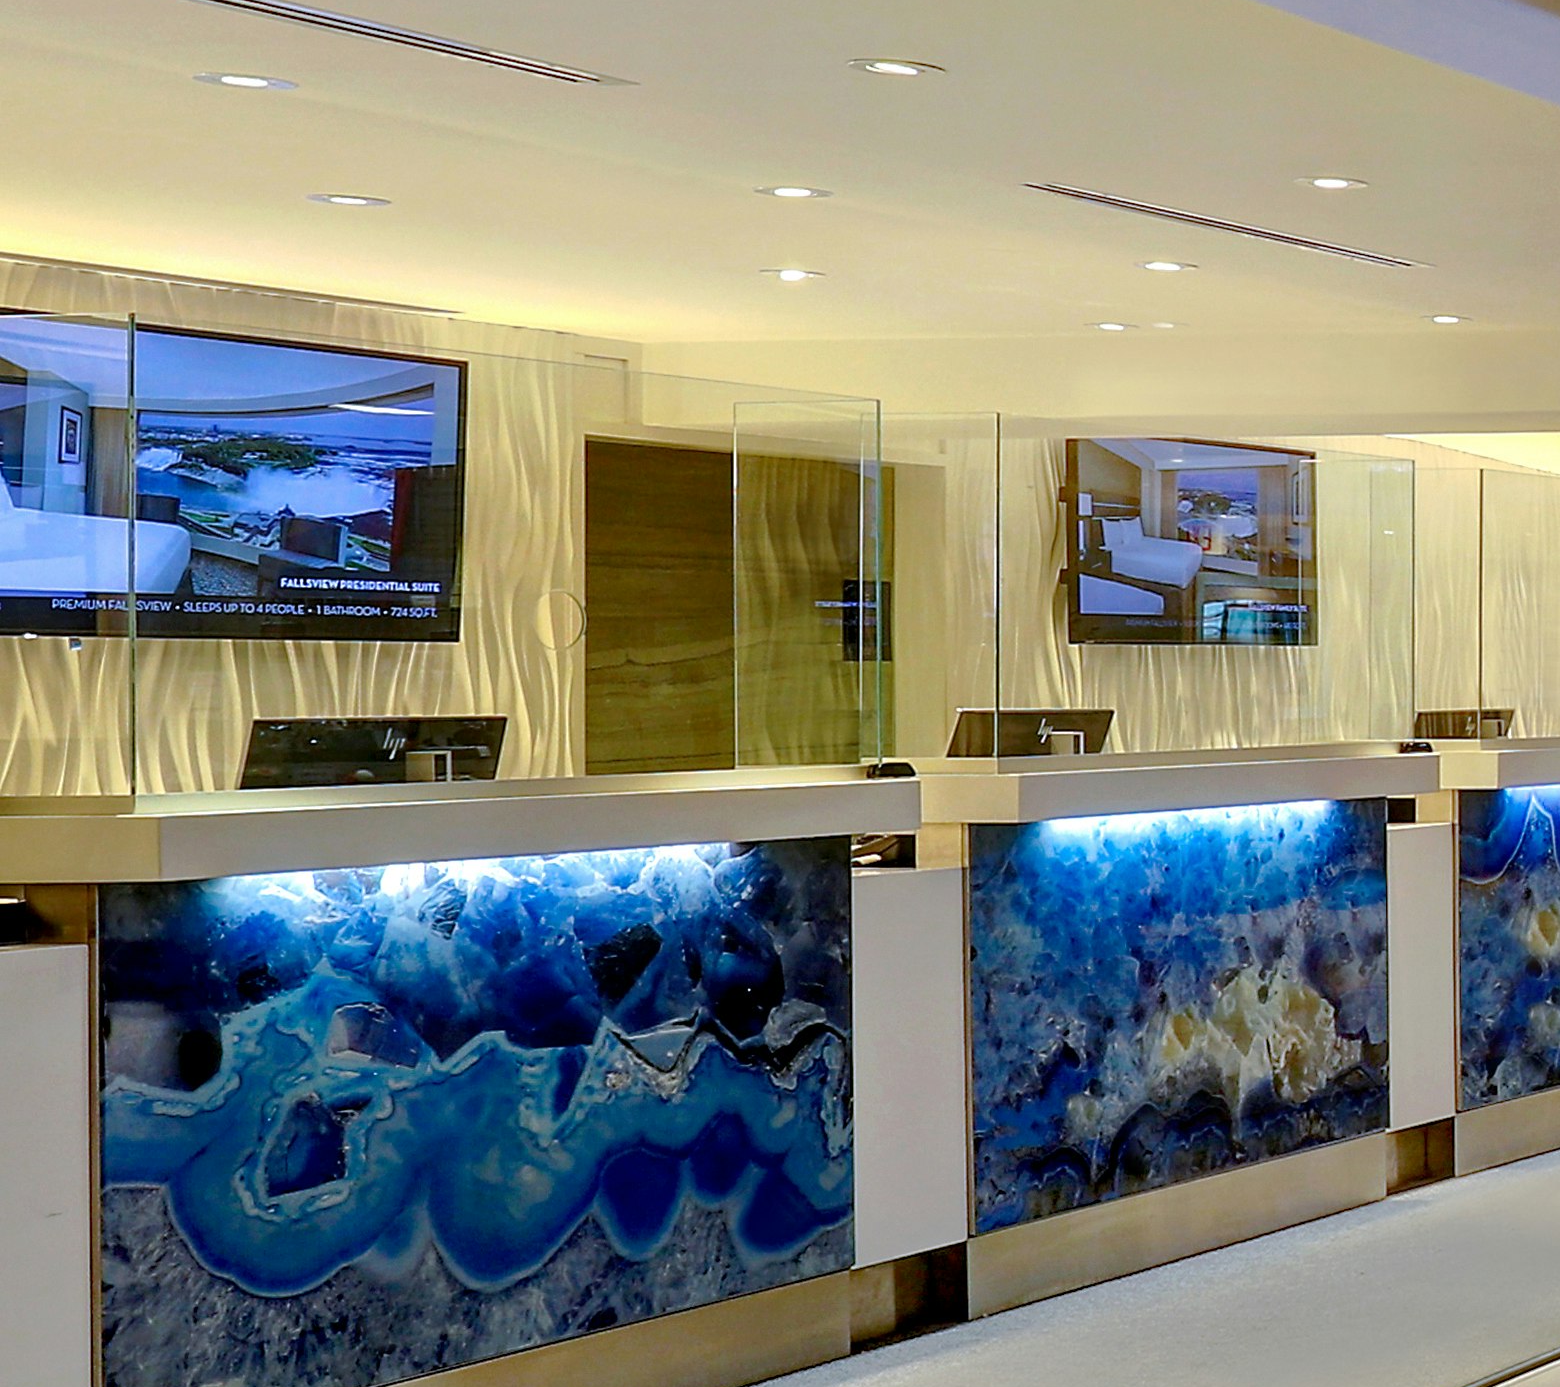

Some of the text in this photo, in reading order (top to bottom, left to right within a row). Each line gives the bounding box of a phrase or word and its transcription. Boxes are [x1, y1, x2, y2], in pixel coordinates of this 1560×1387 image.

[280, 577, 441, 593] FALLSVIEW PRESIDENTIAL SUITE
[52, 599, 107, 610] PREMIUM
[108, 600, 172, 611] FALSVIEW
[183, 601, 222, 612] SLEEPS
[224, 602, 239, 613] UP
[240, 603, 255, 614] TO
[256, 603, 264, 614] 4
[266, 604, 304, 614] PEOPLE
[324, 605, 381, 616] BATHROOM
